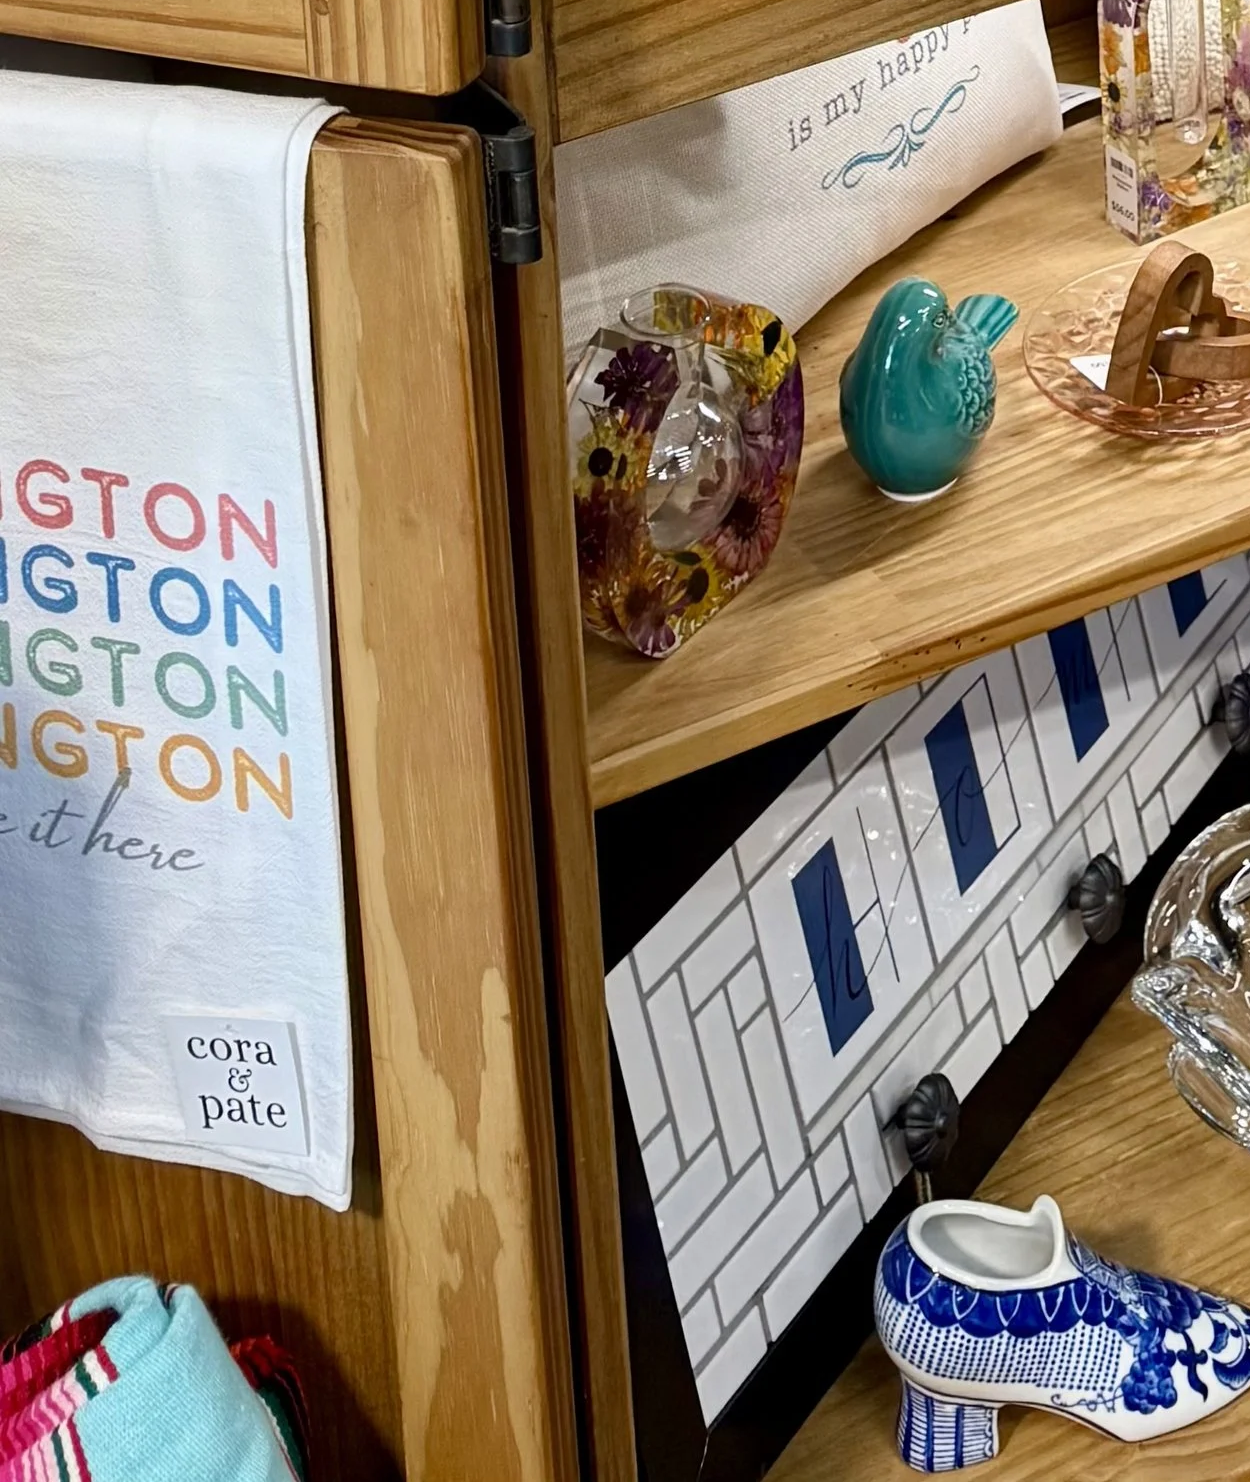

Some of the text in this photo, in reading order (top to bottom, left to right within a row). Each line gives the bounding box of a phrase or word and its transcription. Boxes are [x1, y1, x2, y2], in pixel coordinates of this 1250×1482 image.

[788, 23, 950, 152] is my happy
[0, 459, 279, 569] GTON
[0, 537, 284, 654] GTON
[0, 620, 289, 737] GTON
[29, 767, 205, 871] it here
[187, 1034, 277, 1067] cora
[226, 1067, 253, 1092] &
[197, 1091, 288, 1130] pate
